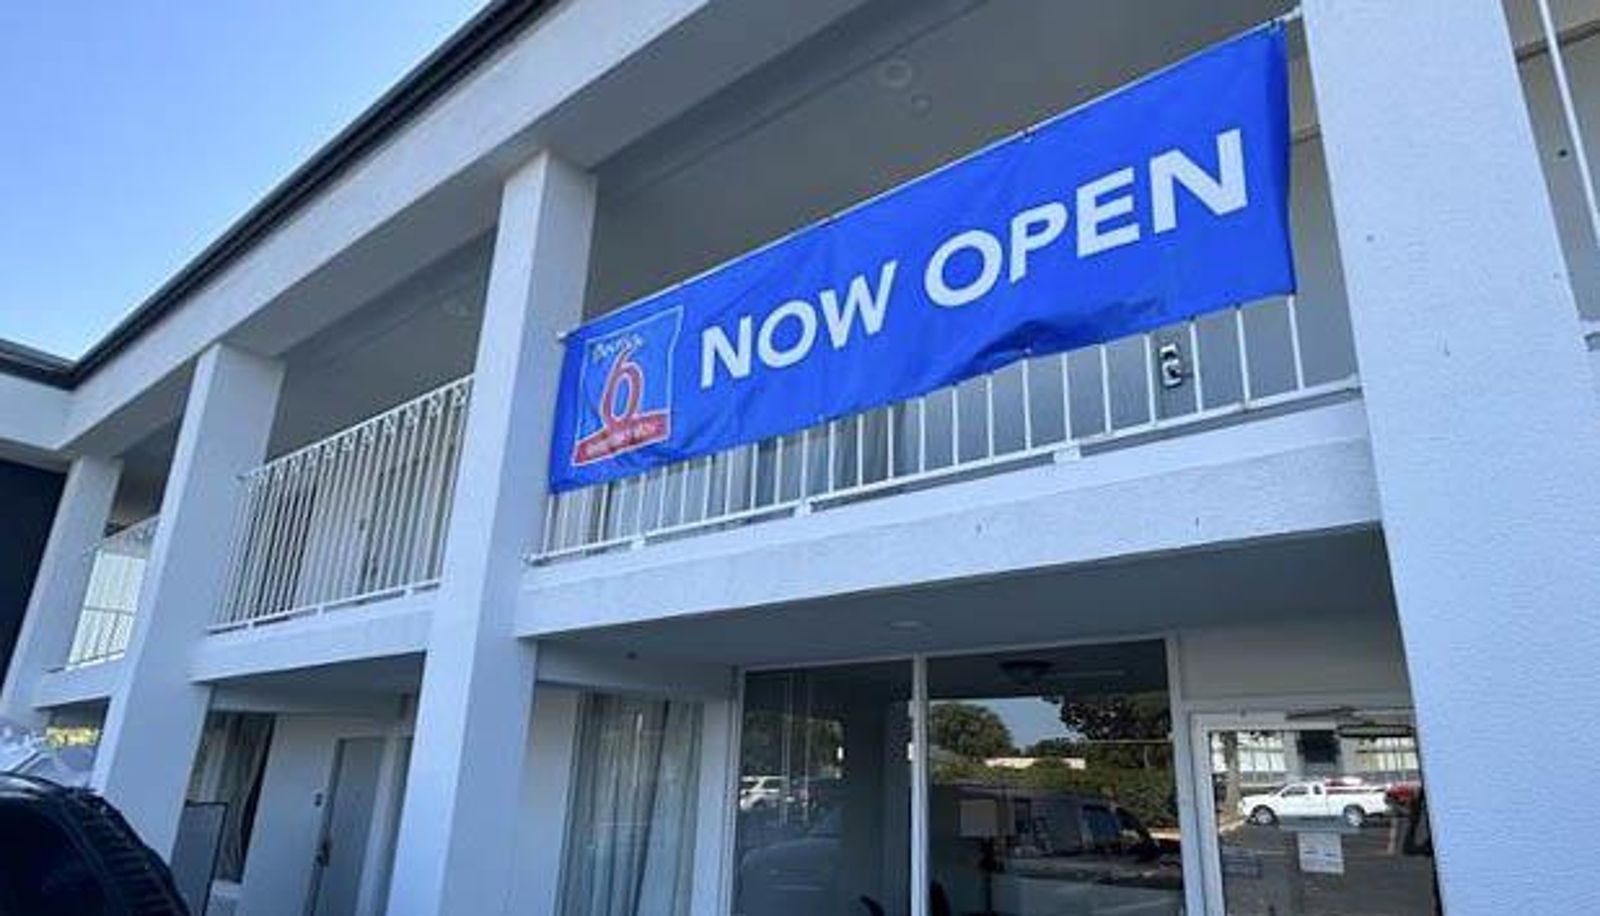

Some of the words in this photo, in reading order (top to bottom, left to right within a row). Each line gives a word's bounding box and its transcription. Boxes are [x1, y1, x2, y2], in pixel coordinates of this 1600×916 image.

[700, 261, 898, 389] NOW
[924, 129, 1249, 308] OPEN
[600, 344, 645, 428] 6
